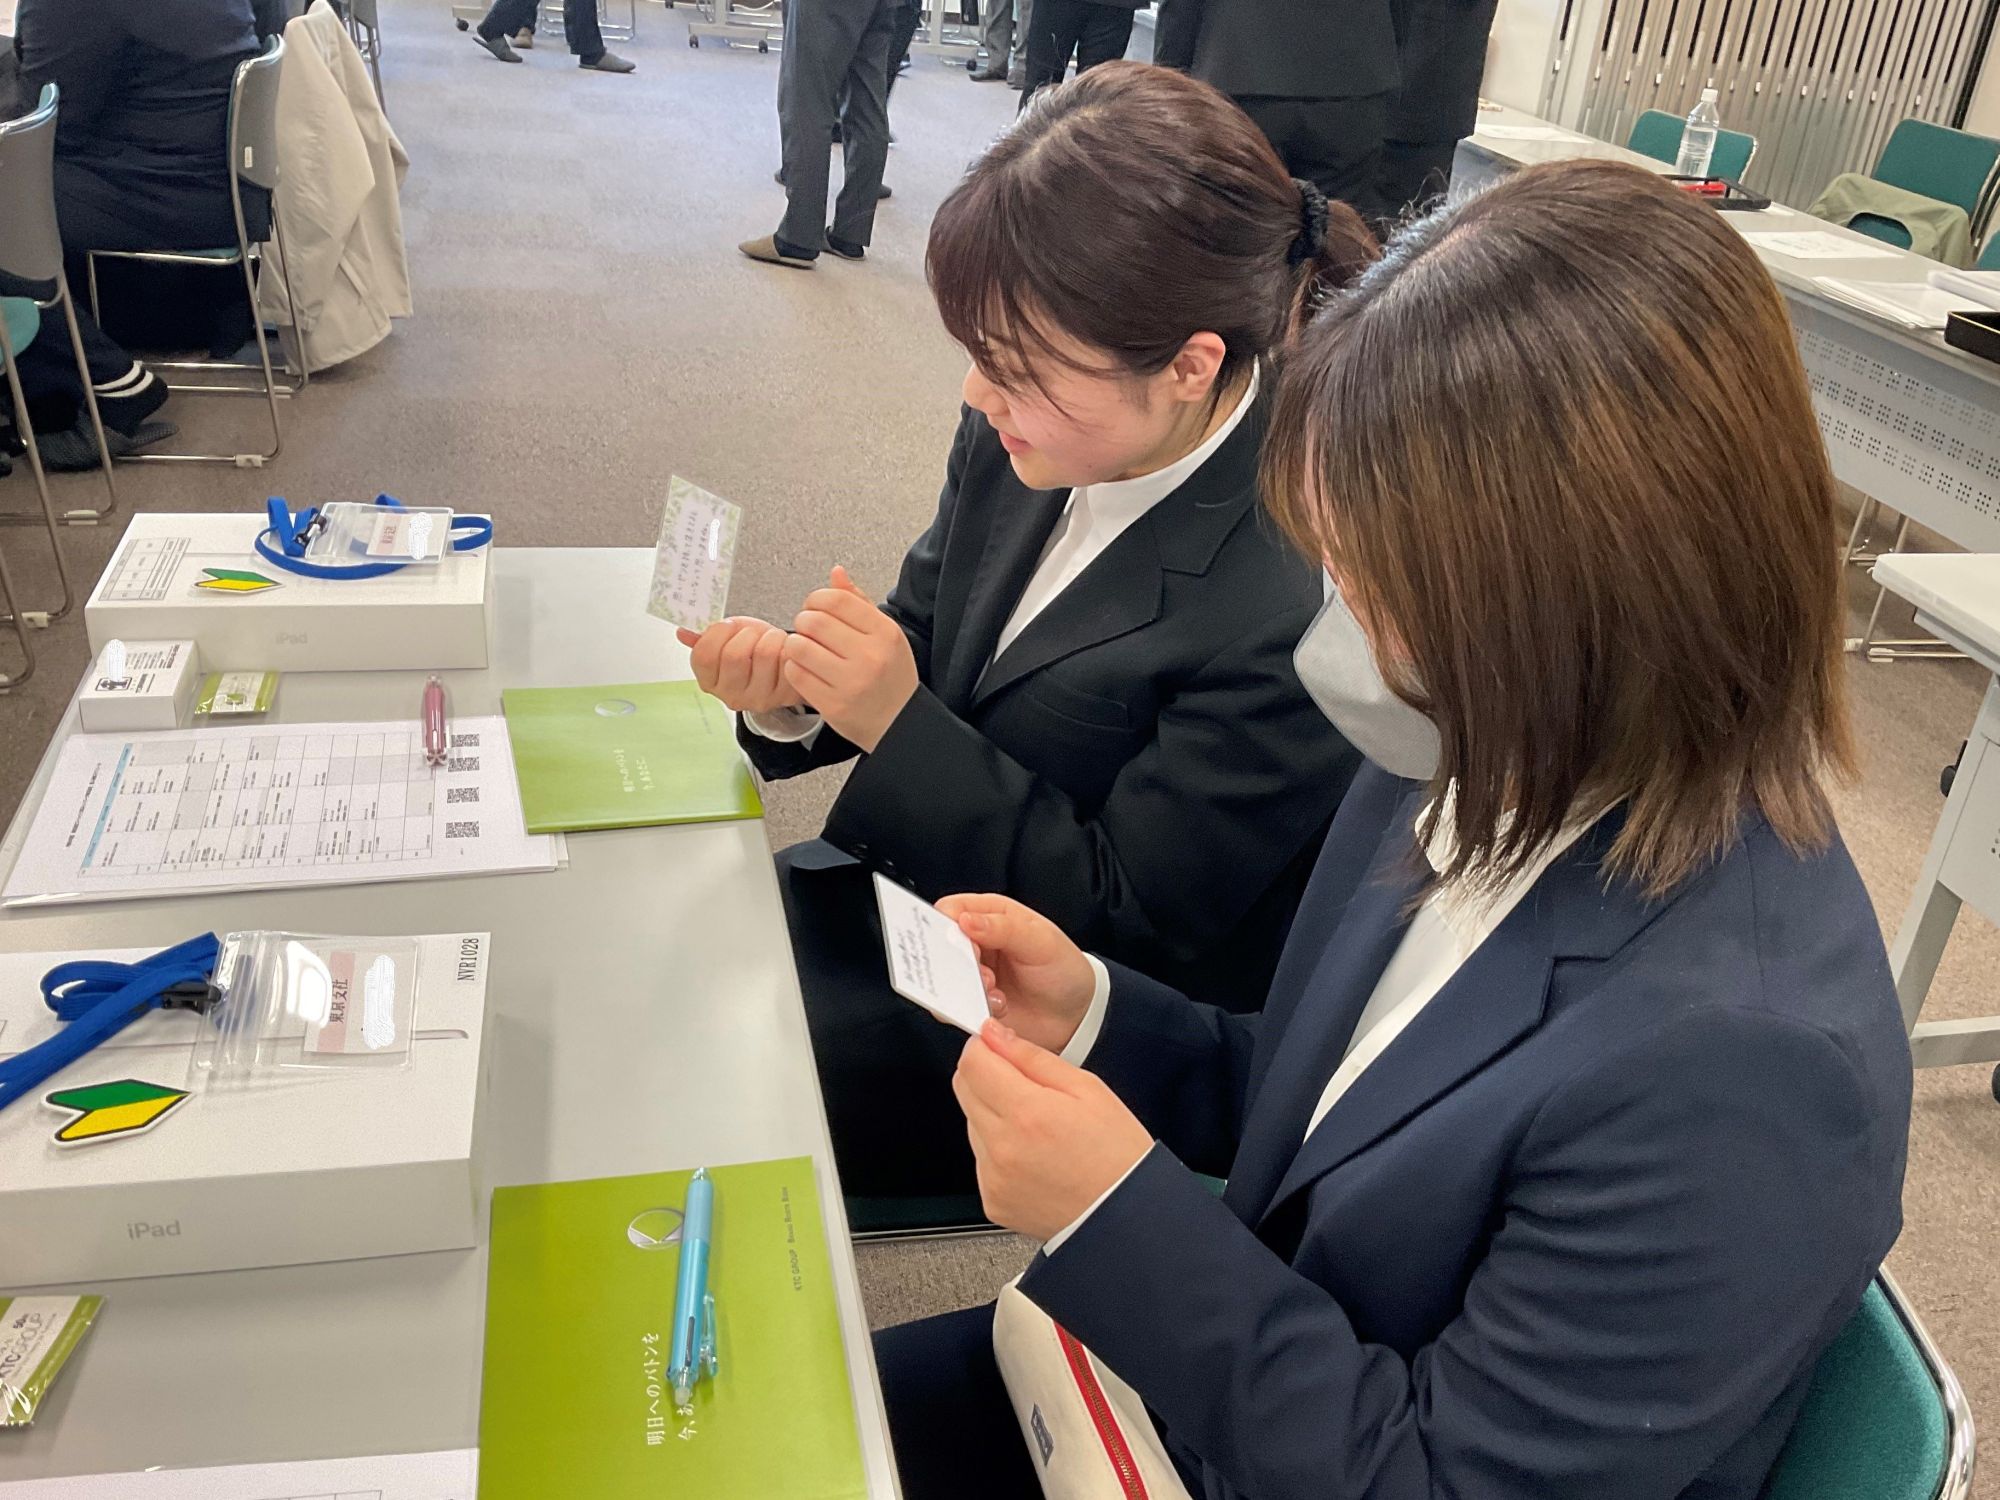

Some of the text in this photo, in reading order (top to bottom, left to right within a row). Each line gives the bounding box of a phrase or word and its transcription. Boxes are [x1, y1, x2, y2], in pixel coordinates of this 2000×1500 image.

[457, 938, 479, 981] NVR1028
[127, 1219, 181, 1240] iPad
[641, 1332, 665, 1446] 明日へのバトンを
